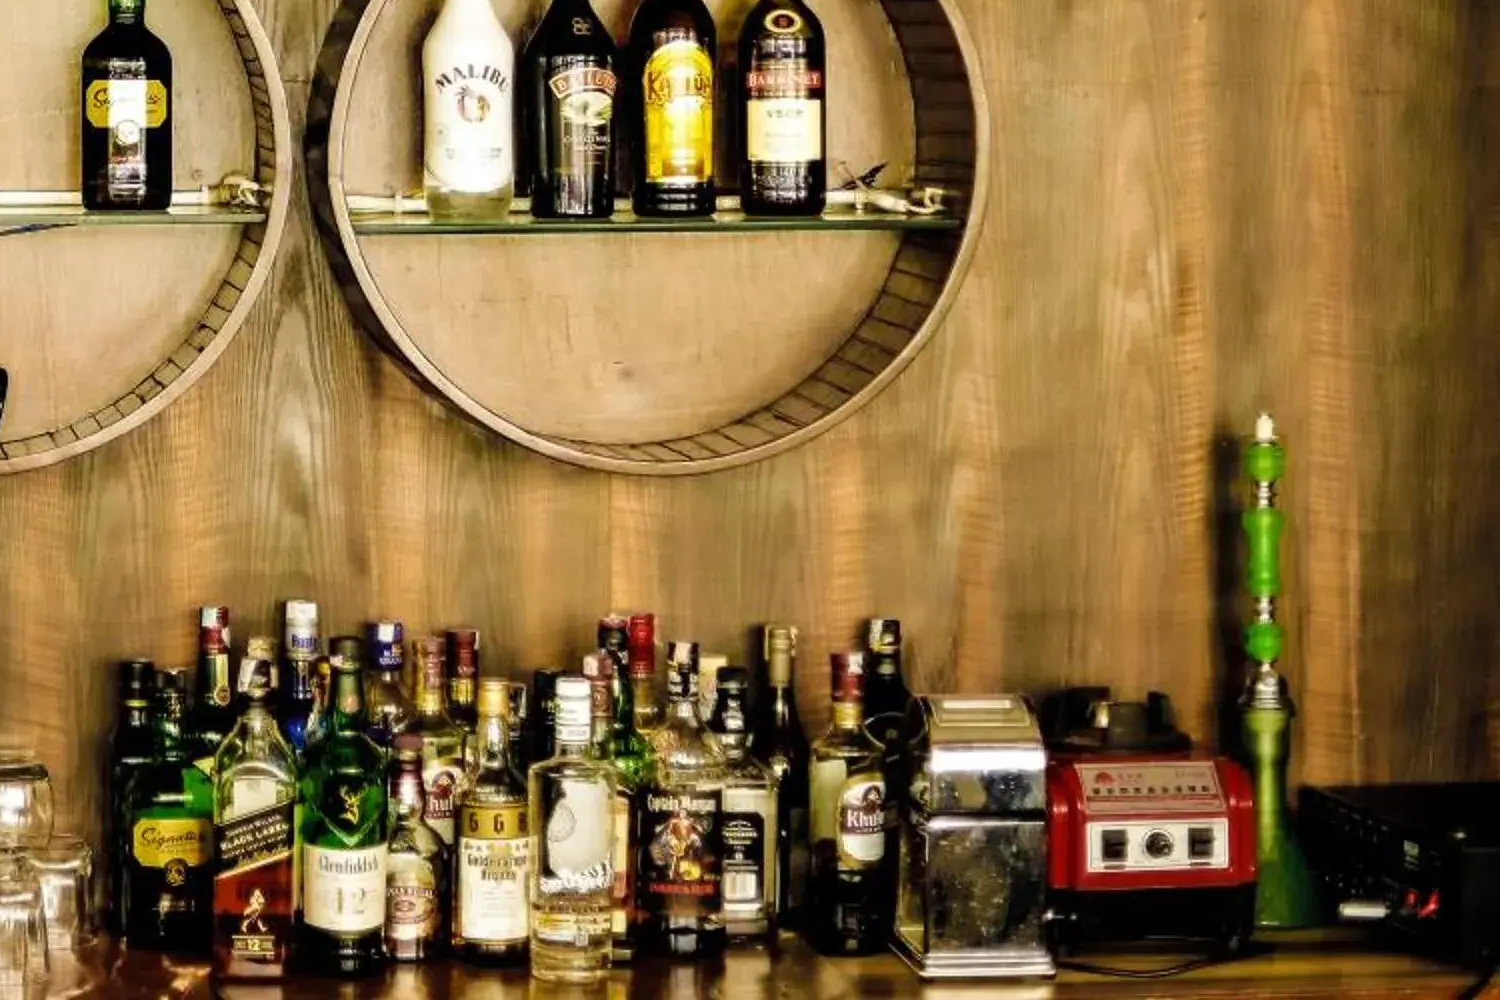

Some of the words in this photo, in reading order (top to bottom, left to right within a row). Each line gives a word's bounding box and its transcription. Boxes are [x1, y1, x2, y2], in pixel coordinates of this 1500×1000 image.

[435, 64, 509, 95] MALIBU
[555, 70, 614, 90] BILEYS
[336, 887, 366, 915] 12
[247, 938, 261, 951] 12
